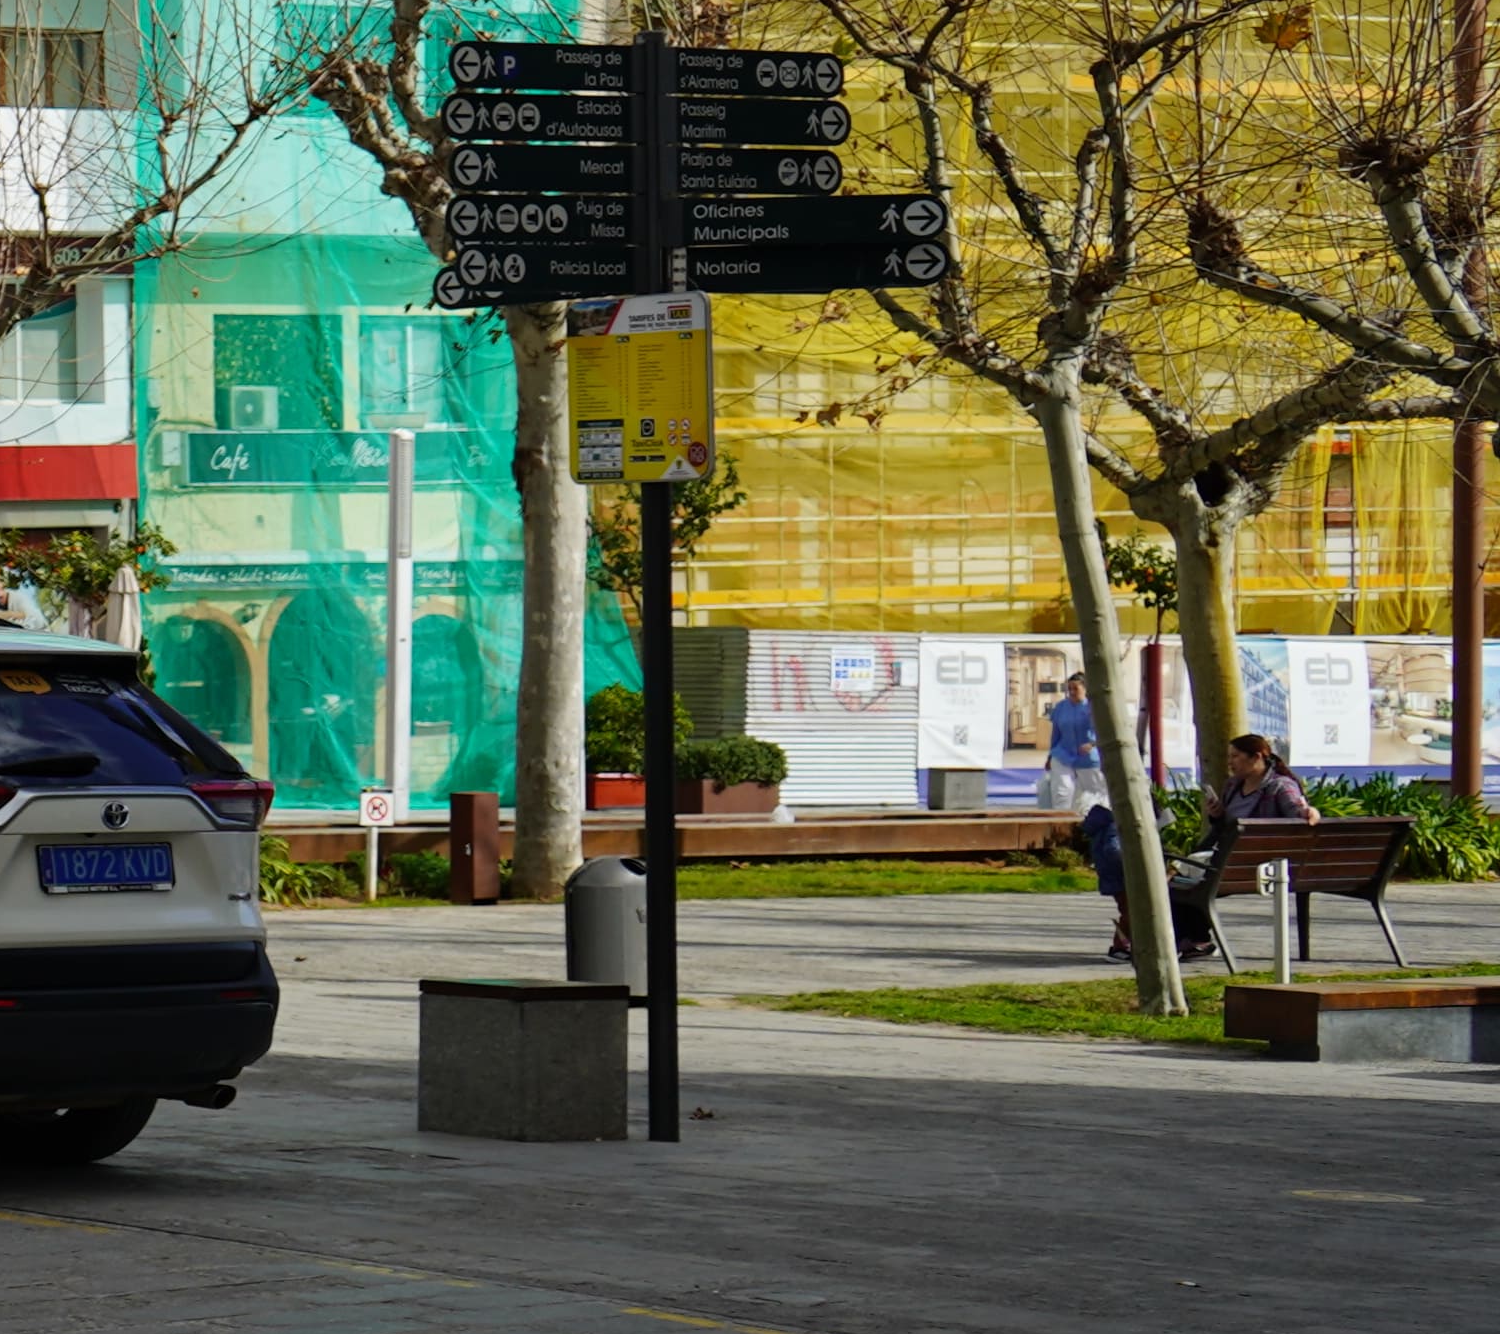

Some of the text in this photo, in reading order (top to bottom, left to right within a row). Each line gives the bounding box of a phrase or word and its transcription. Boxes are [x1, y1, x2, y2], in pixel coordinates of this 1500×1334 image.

[555, 49, 623, 68] Passeig de
[679, 52, 744, 71] Passeig de
[584, 72, 623, 87] la Pau
[680, 75, 739, 90] s'Alamera
[576, 100, 622, 115] Estació
[680, 102, 726, 120] Passeig
[546, 122, 623, 137] d'Autobusos
[580, 160, 624, 174] Mercat
[680, 153, 733, 169] Platja de
[681, 174, 716, 188] Santa
[576, 201, 624, 219] Puig de
[693, 203, 765, 219] Oficines
[590, 223, 625, 238] Missa
[694, 224, 790, 242] Municipals
[593, 261, 626, 276] Local
[696, 260, 761, 276] Notaria
[210, 442, 251, 480] Café
[60, 849, 169, 880] 1872 KVD
